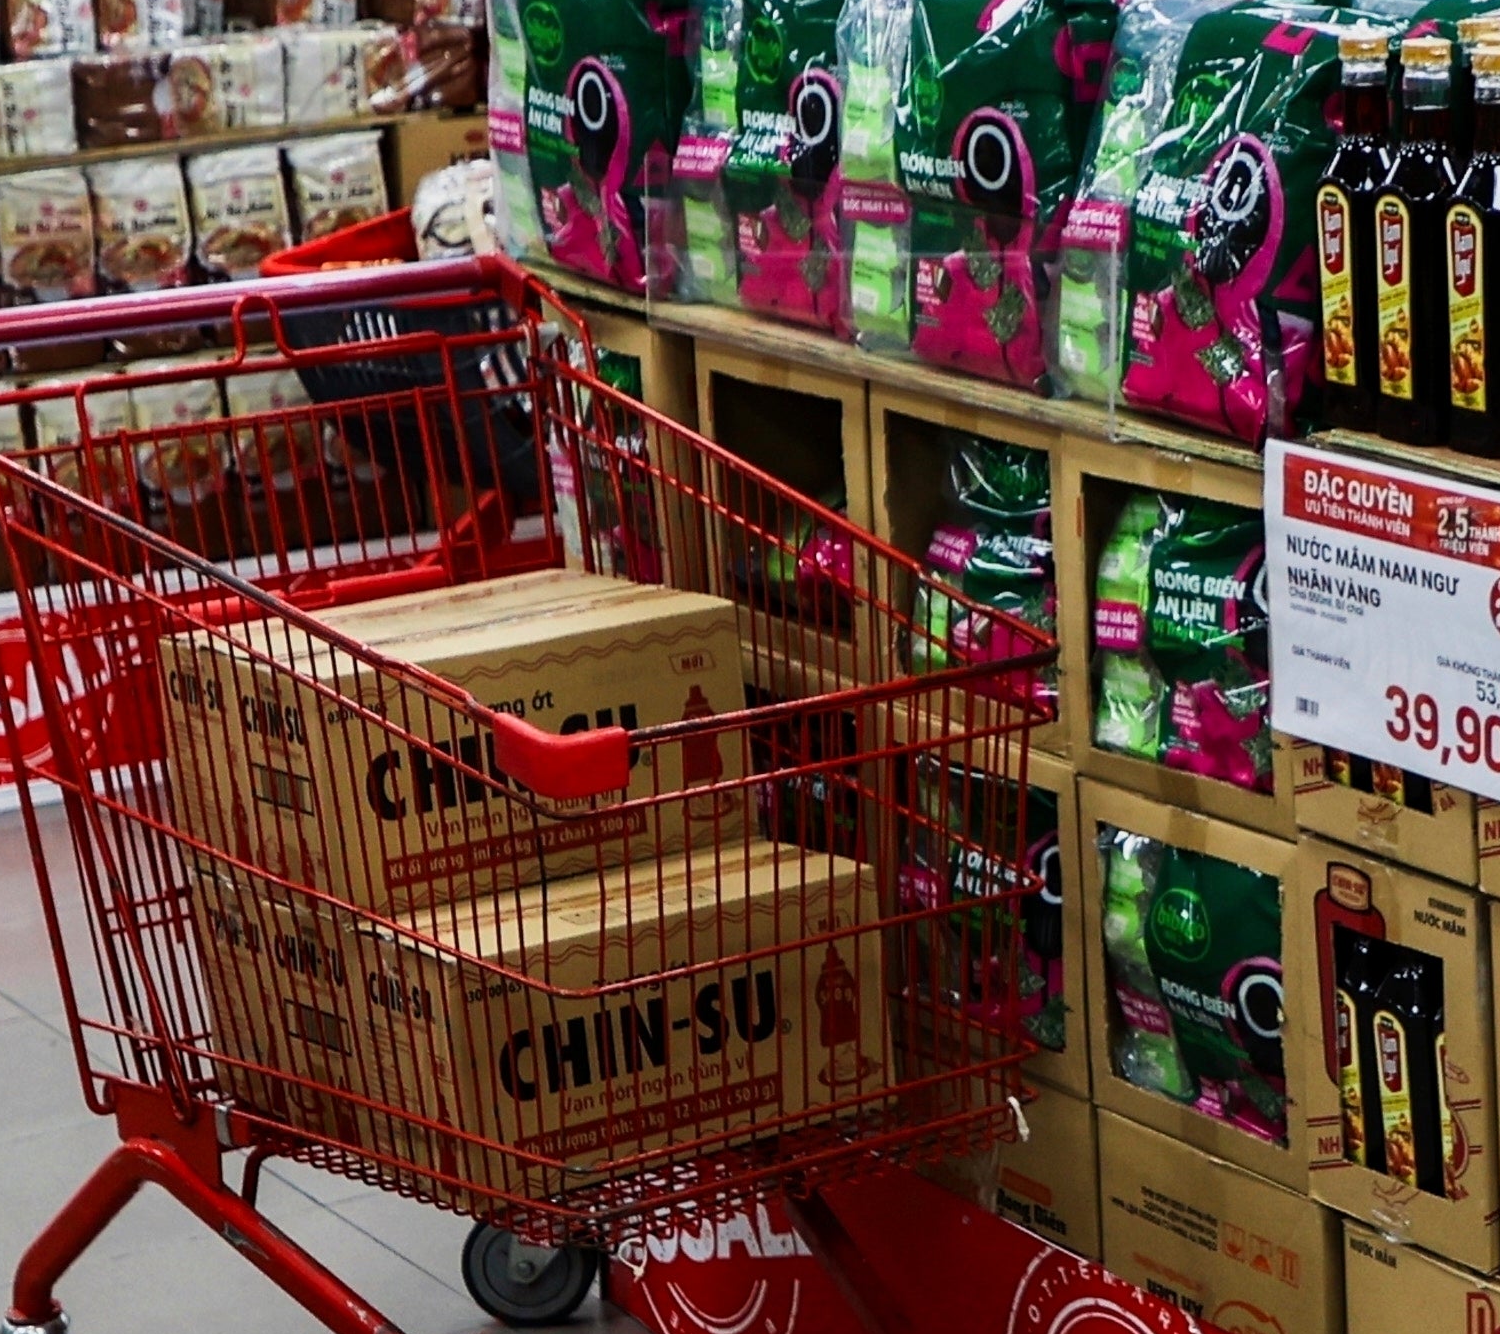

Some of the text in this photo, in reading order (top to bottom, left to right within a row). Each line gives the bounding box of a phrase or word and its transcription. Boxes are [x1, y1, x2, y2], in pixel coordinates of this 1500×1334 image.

[1348, 481, 1413, 517] QUYỀN
[1348, 508, 1384, 531] THÀNH
[1386, 518, 1410, 538] VIÊN
[1155, 568, 1199, 594] RONG
[1287, 534, 1332, 562] NƯỚC
[1379, 559, 1417, 586] NAM
[1422, 573, 1459, 596] NGƯ
[1288, 566, 1381, 608] NHÃN VÀNG
[499, 969, 777, 1102] CHIN-SU
